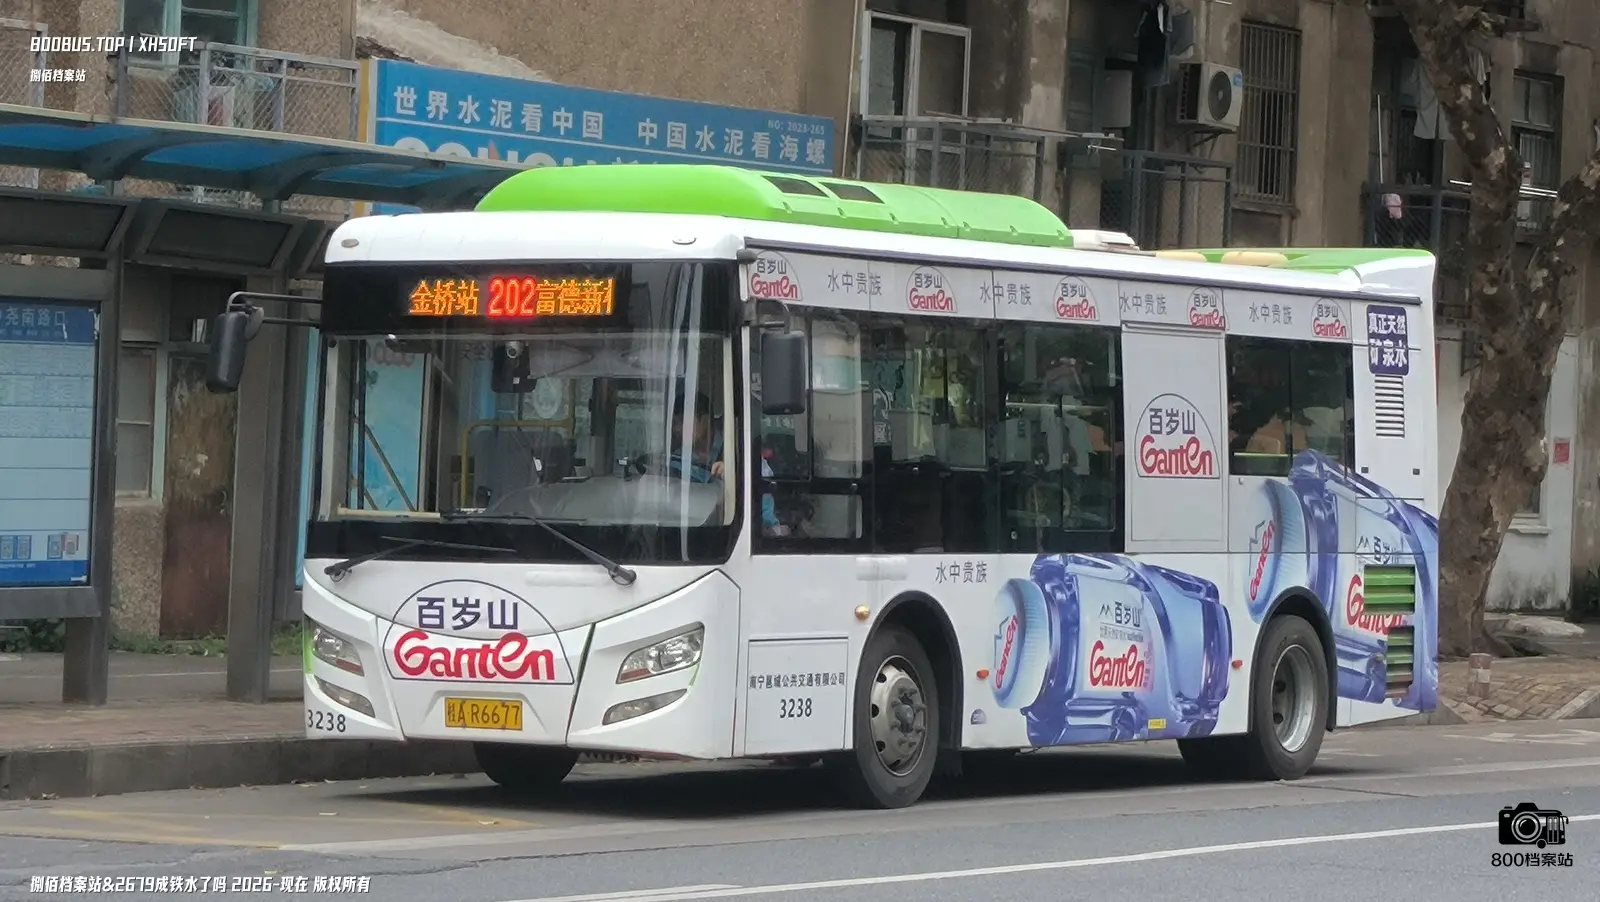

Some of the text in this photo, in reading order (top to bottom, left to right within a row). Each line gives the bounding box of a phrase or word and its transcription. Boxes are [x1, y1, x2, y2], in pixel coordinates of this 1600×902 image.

[393, 86, 604, 140] 世界水泥看中国
[638, 117, 825, 165] 中国水泥看海螺
[756, 257, 787, 275] 百岁山
[751, 273, 798, 299] Ganten
[827, 269, 882, 296] 水中贵族
[914, 272, 943, 289] 百岁山
[1061, 283, 1087, 298] 百岁山
[409, 279, 479, 316] 金桥站
[487, 276, 535, 317] 202
[909, 289, 953, 312] Ganten
[979, 281, 1032, 306] 水中贵族
[1118, 291, 1167, 316] 水中贵族
[1193, 293, 1217, 309] 百岁山
[0, 305, 65, 328] 尧南路口
[1056, 296, 1096, 320] Ganten
[1248, 302, 1292, 325] 水中贵族
[1316, 303, 1339, 318] 百岁山
[1313, 317, 1347, 338] Ganten
[1368, 312, 1406, 335] 真正天然
[1369, 338, 1408, 368] 矿泉水
[1149, 407, 1196, 436] 百岁山
[1140, 434, 1213, 476] Ganten
[935, 560, 988, 584] 水中贵族
[417, 596, 519, 631] 百岁山
[1114, 600, 1141, 628] 百岁山
[393, 629, 556, 681] Ganten
[1089, 639, 1145, 688] Ganten
[779, 697, 813, 719] 3238
[307, 709, 347, 733] 3238
